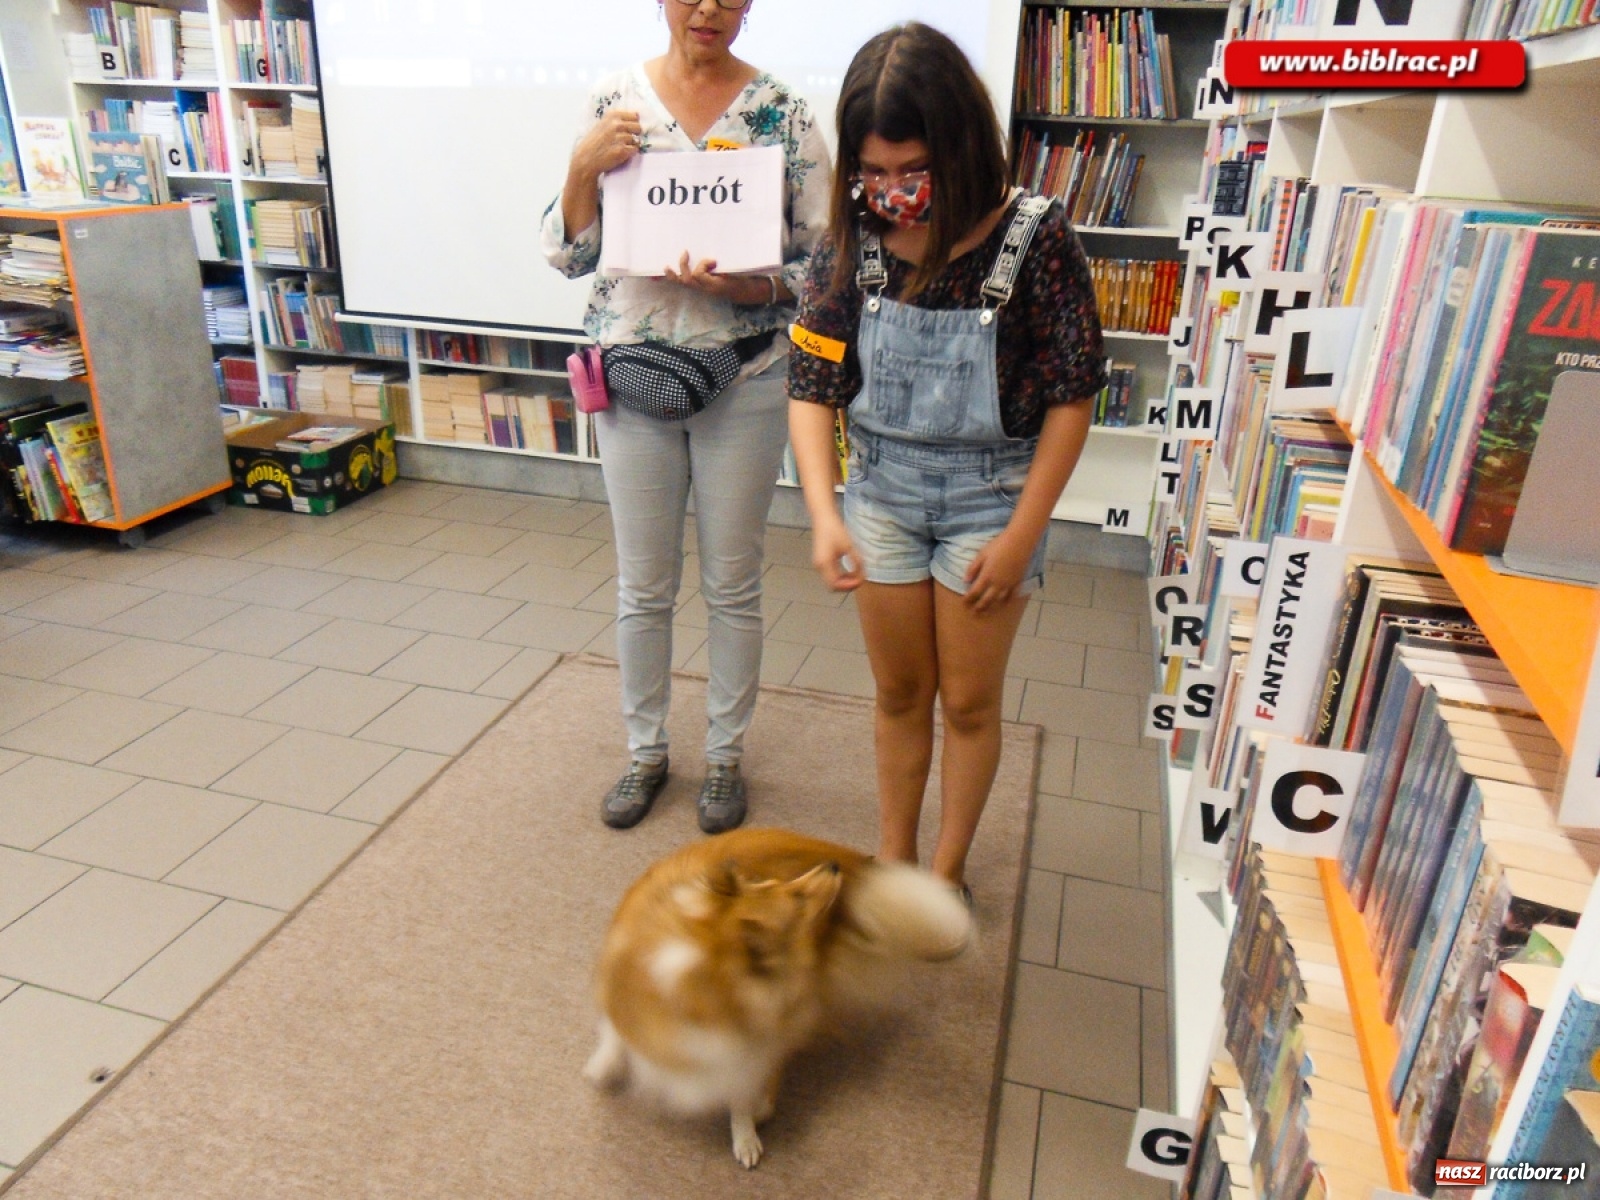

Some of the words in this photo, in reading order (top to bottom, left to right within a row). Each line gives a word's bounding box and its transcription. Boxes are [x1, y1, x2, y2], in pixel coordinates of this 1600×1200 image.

[103, 53, 117, 71] B
[1208, 78, 1234, 104] N
[168, 149, 182, 166] C
[647, 176, 743, 206] obrót
[1185, 216, 1205, 241] P
[1216, 245, 1255, 279] K
[1173, 326, 1192, 347] J
[1285, 331, 1333, 389] L
[1555, 351, 1580, 367] KTO
[1148, 406, 1167, 425] K
[1176, 399, 1213, 429] M
[1160, 442, 1178, 463] L
[1161, 472, 1181, 495] T
[1106, 508, 1130, 528] M
[1171, 615, 1203, 646] R
[1255, 551, 1310, 721] FANTASTYKA
[1183, 683, 1216, 718] S
[1153, 705, 1176, 730] S
[1271, 770, 1344, 834] C
[1140, 1128, 1192, 1166] G
